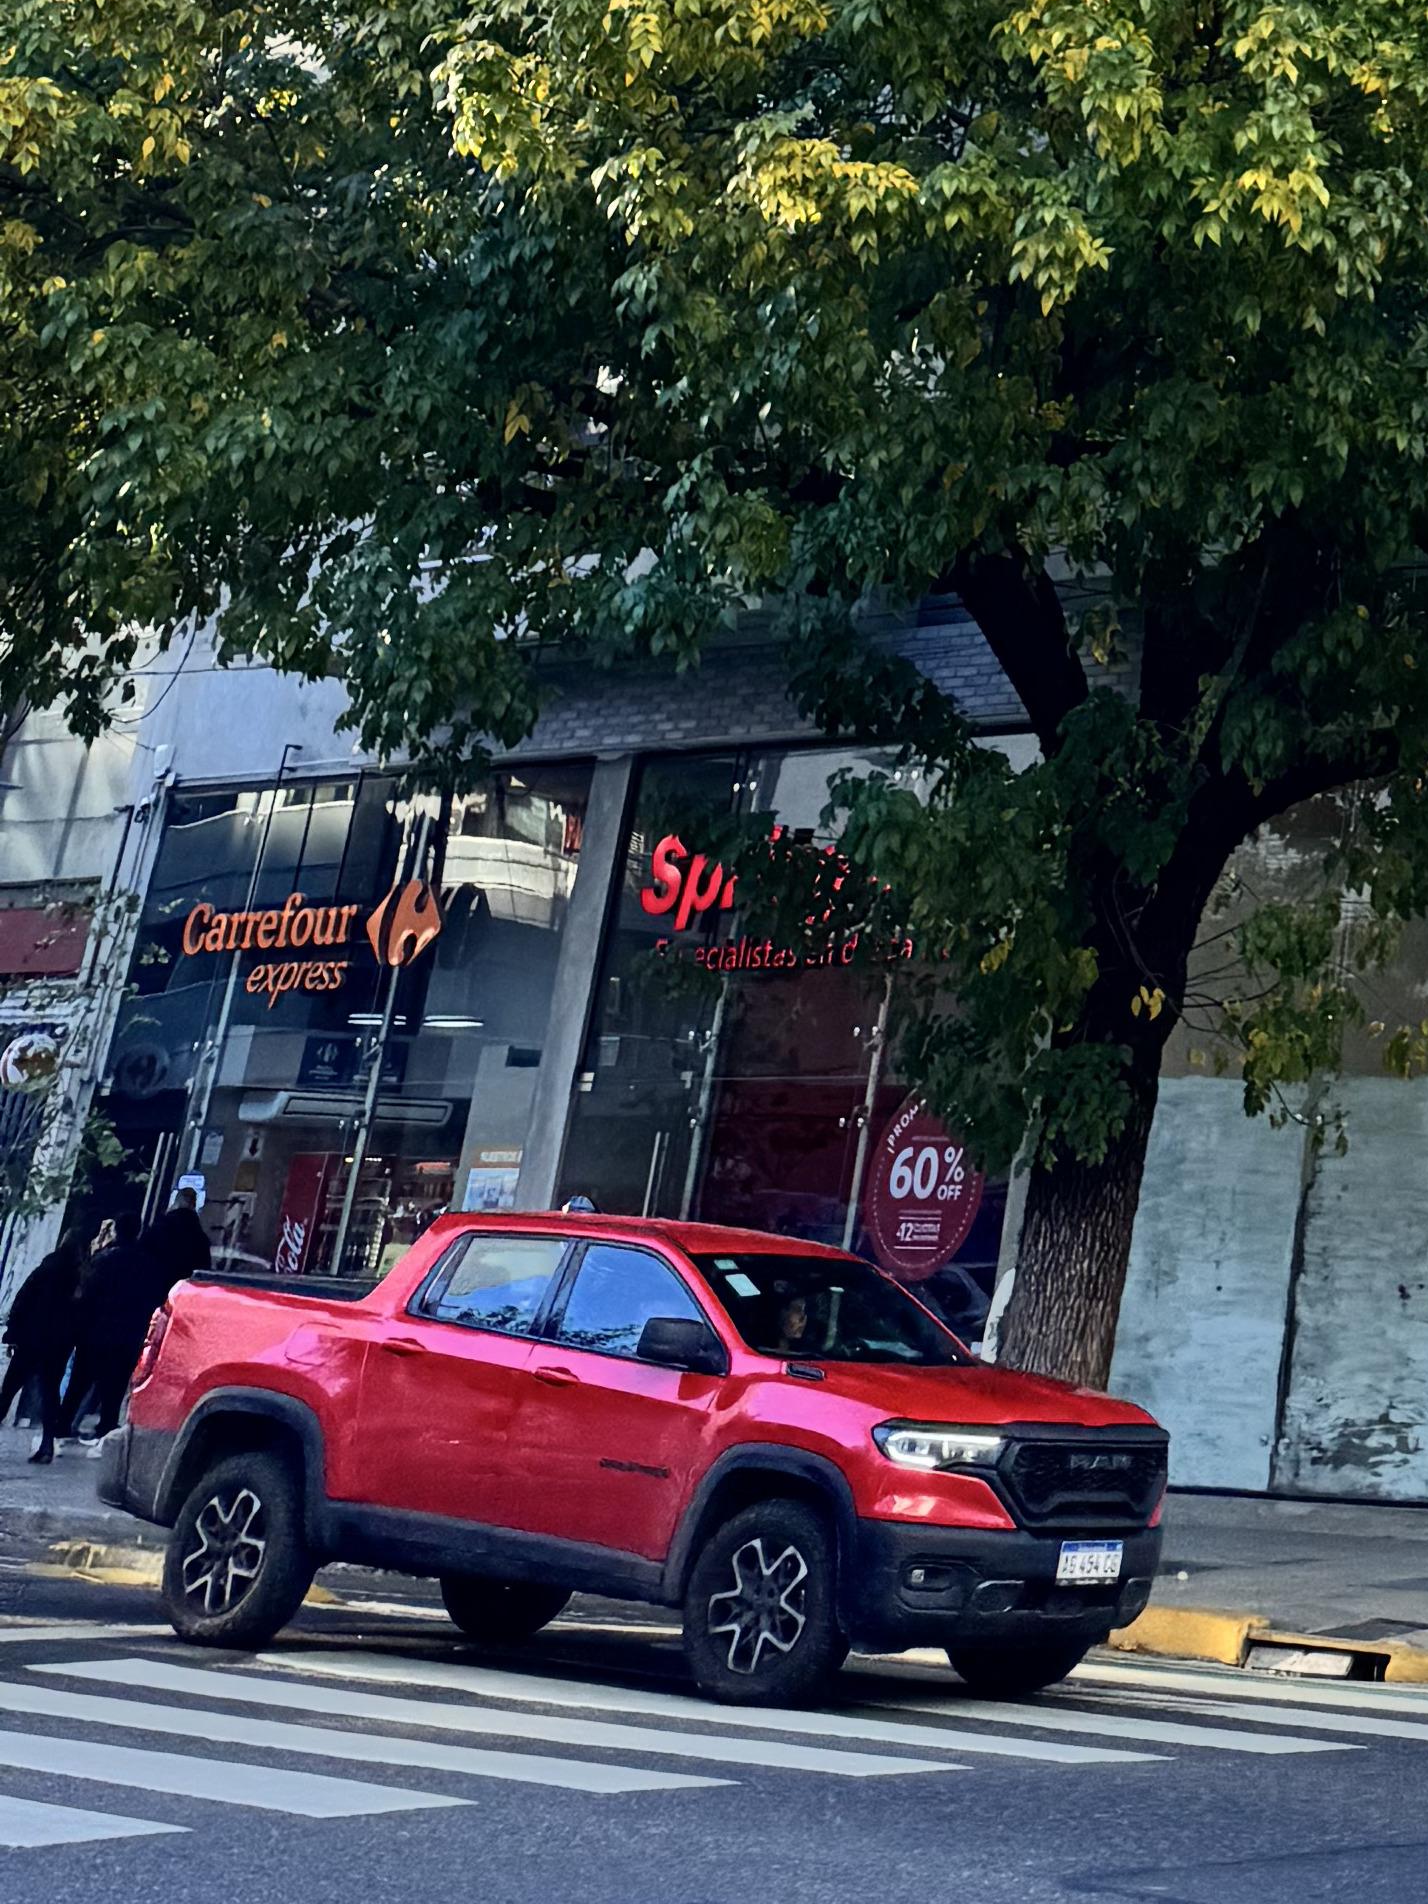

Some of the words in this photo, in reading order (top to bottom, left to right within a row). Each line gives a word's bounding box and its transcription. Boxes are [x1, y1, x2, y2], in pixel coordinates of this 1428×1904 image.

[183, 892, 358, 956] Carrefour
[246, 960, 348, 1011] express
[937, 1184, 964, 1201] OFF
